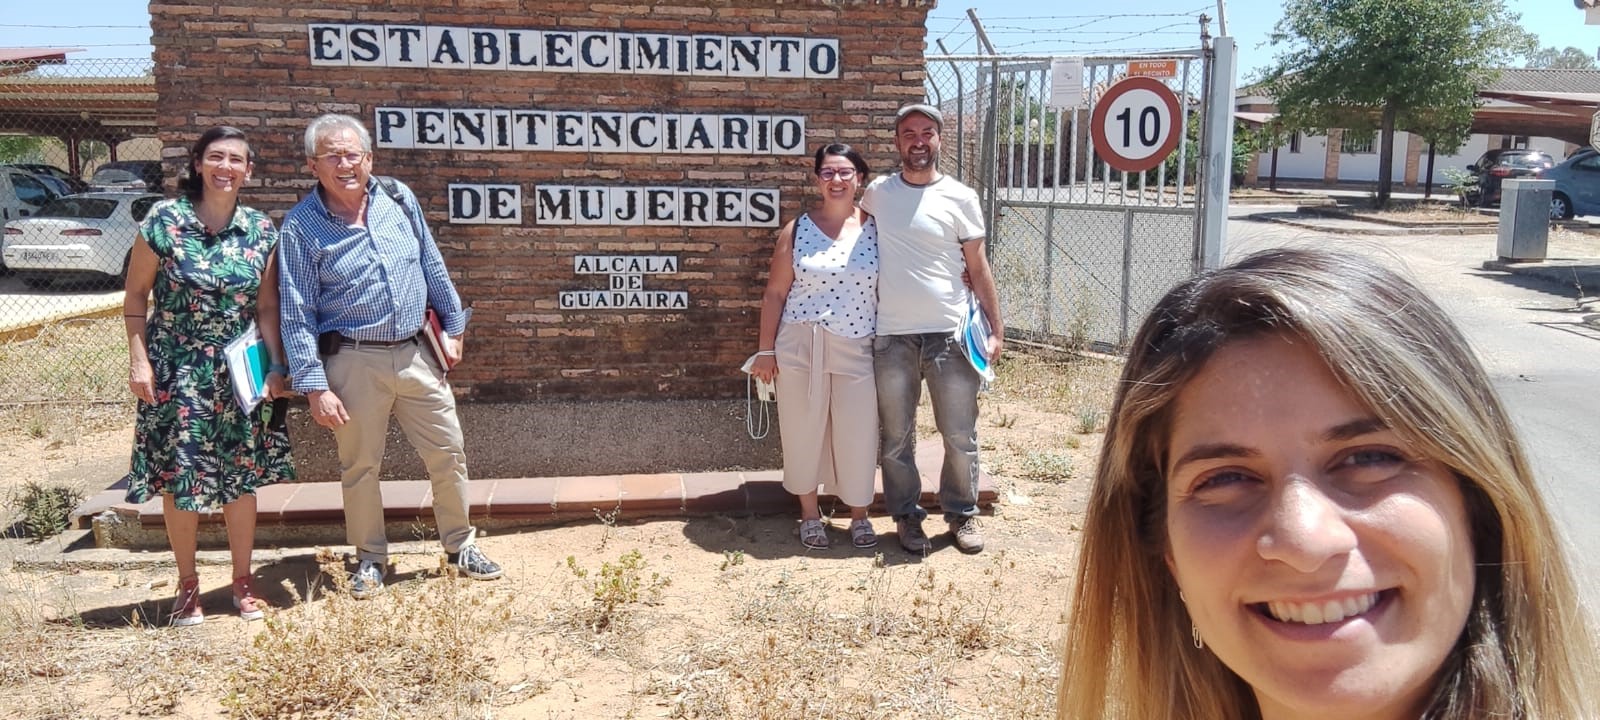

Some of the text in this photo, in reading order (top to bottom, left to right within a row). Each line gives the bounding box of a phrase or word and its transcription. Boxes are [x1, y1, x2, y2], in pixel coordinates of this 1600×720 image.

[312, 26, 837, 75] ESTABLECIMIENTO
[377, 110, 802, 151] PENITENCIARIO
[1116, 106, 1160, 147] 10
[451, 187, 776, 223] DE MUJERES
[577, 257, 675, 272] ALCALA
[612, 275, 641, 290] DE
[561, 292, 686, 308] GUADAIRA
